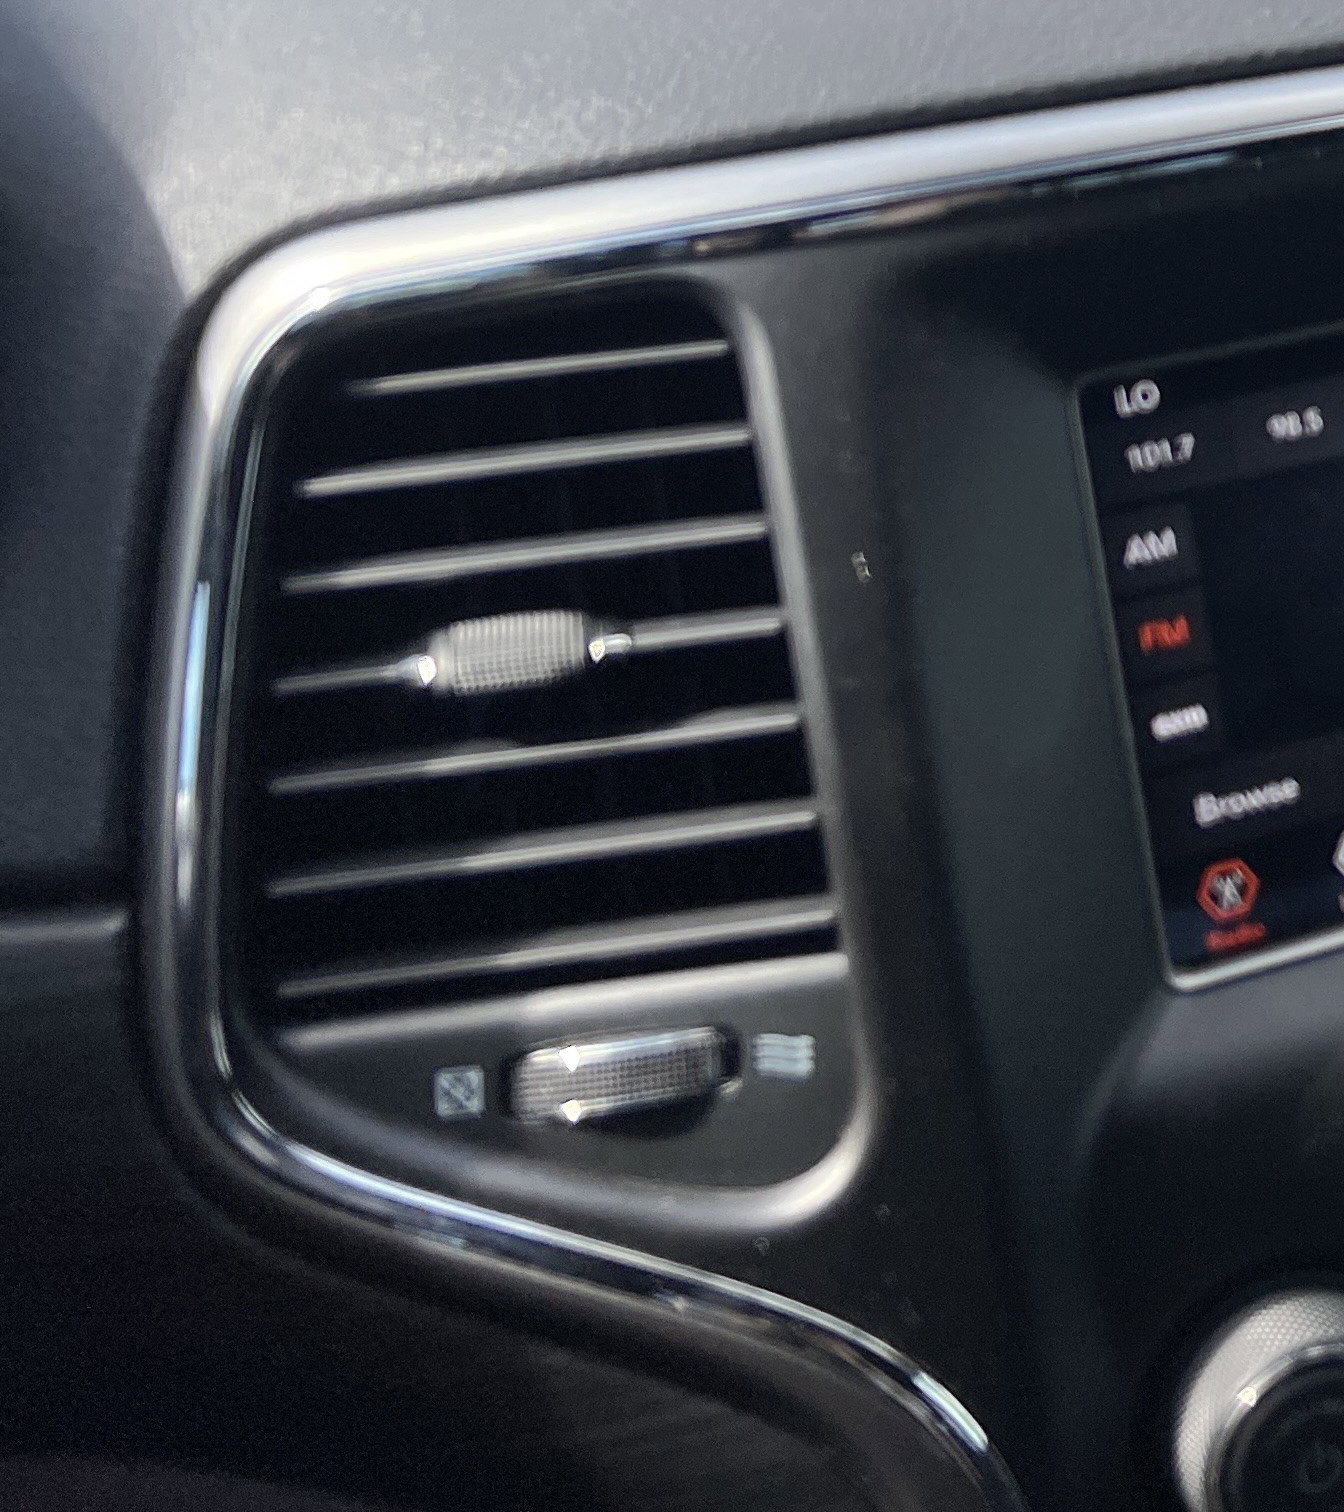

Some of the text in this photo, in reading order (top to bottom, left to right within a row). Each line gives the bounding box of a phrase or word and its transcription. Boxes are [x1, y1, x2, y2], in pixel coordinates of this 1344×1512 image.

[1113, 379, 1161, 418] LO
[1124, 433, 1195, 473] 101.7
[1124, 526, 1179, 569] AM
[1138, 615, 1191, 654] FM
[1193, 776, 1300, 829] Browse
